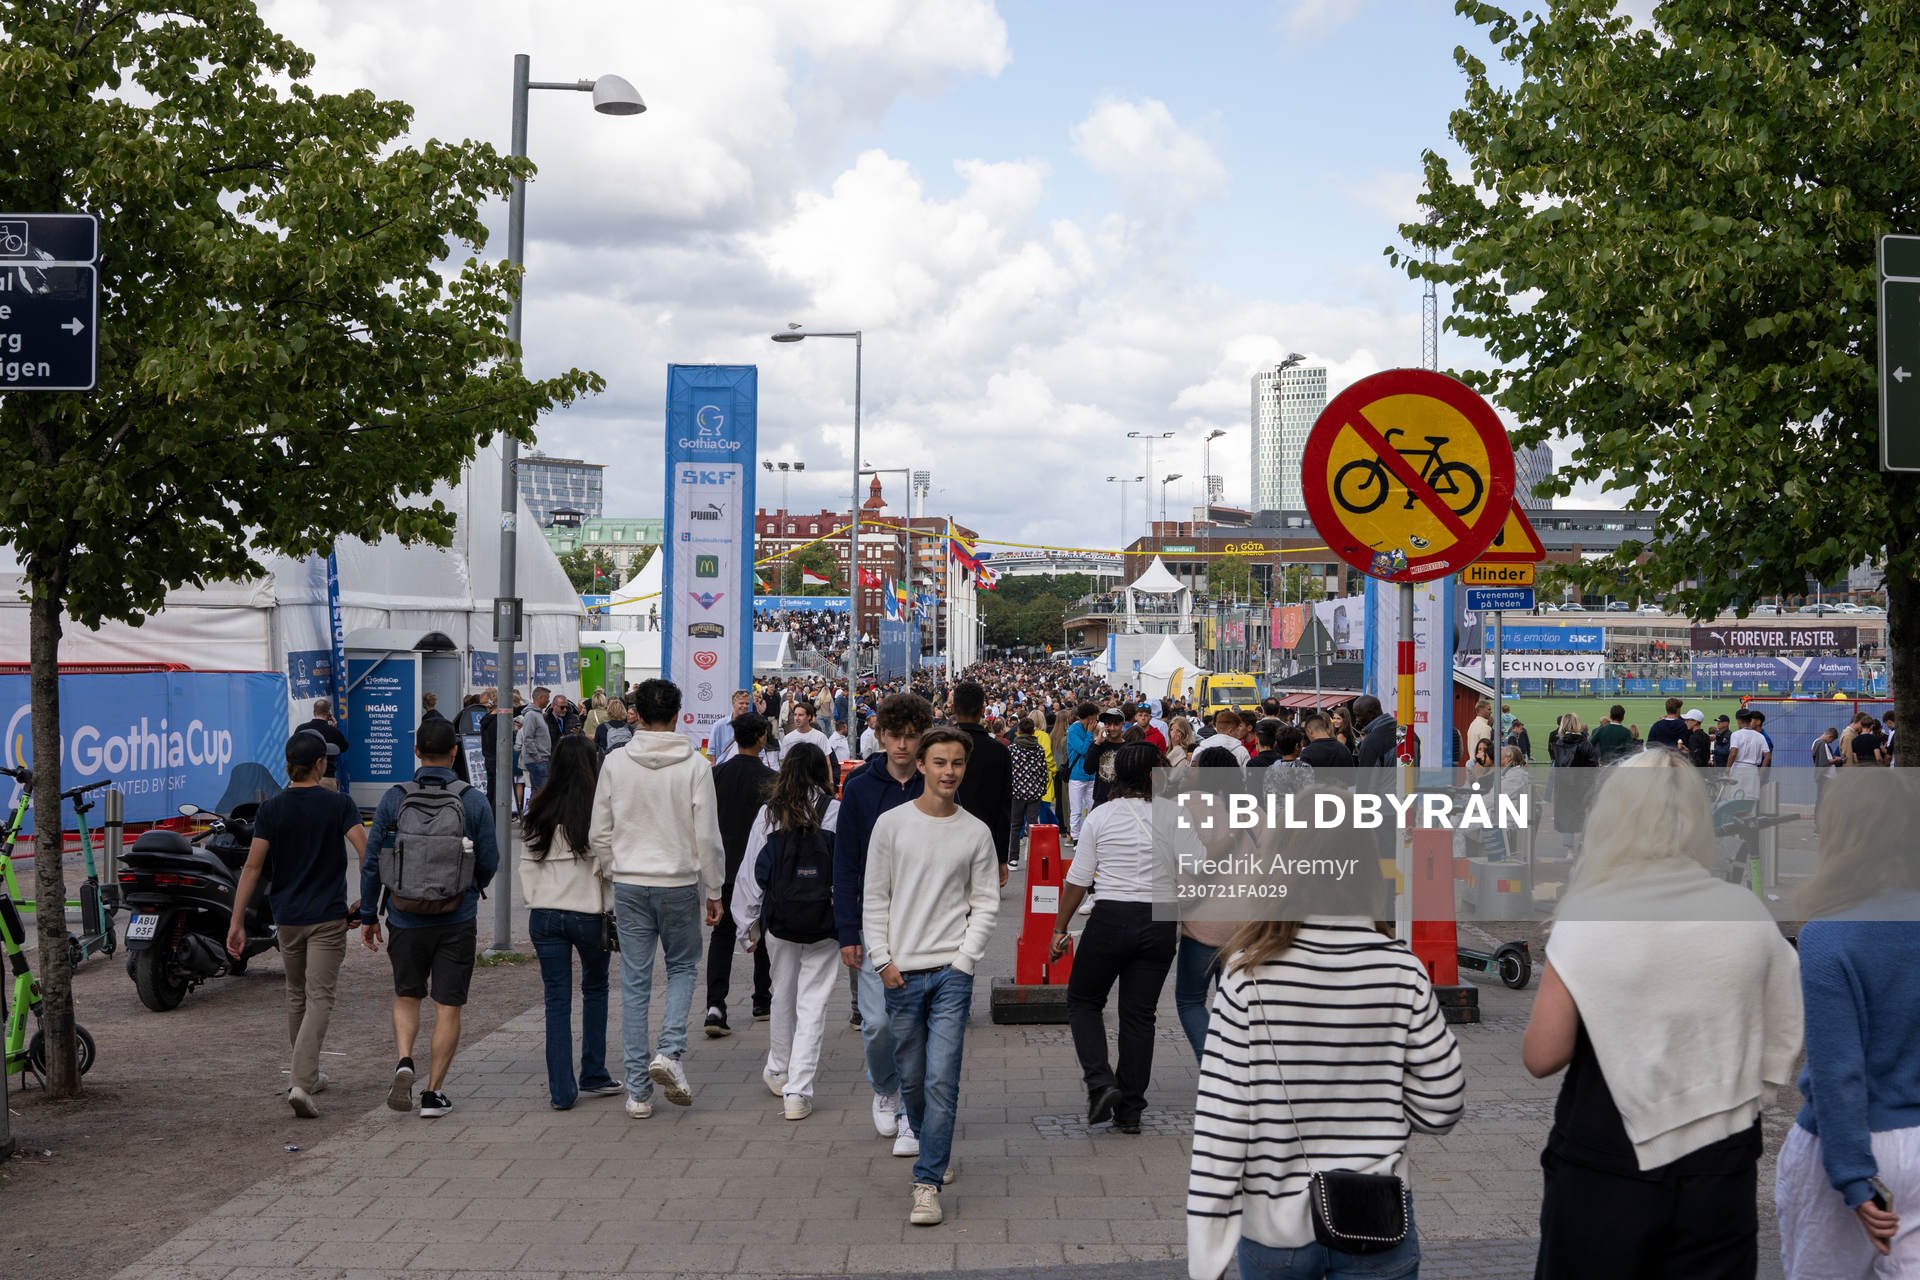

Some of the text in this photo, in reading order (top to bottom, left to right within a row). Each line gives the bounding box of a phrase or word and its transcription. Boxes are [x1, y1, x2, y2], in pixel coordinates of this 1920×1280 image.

[678, 438, 741, 452] Gothia Cup
[681, 470, 736, 485] SKF
[690, 511, 719, 520] PUMA
[1240, 541, 1264, 550] GÖTA
[1471, 567, 1526, 581] Hinder
[1476, 592, 1525, 600] Evenemang
[1513, 633, 1520, 641] is
[1523, 633, 1560, 642] emotion
[1568, 634, 1597, 642] SKF
[1730, 631, 1839, 646] FOREVER. FASTER.
[1502, 661, 1596, 671] ECHNOLOGY
[365, 703, 398, 712] INGÅNG
[71, 717, 233, 776] Gothia Cup
[152, 778, 166, 793] BY
[168, 775, 187, 791] SKF
[137, 917, 157, 926] ABU
[135, 927, 154, 936] 93F
